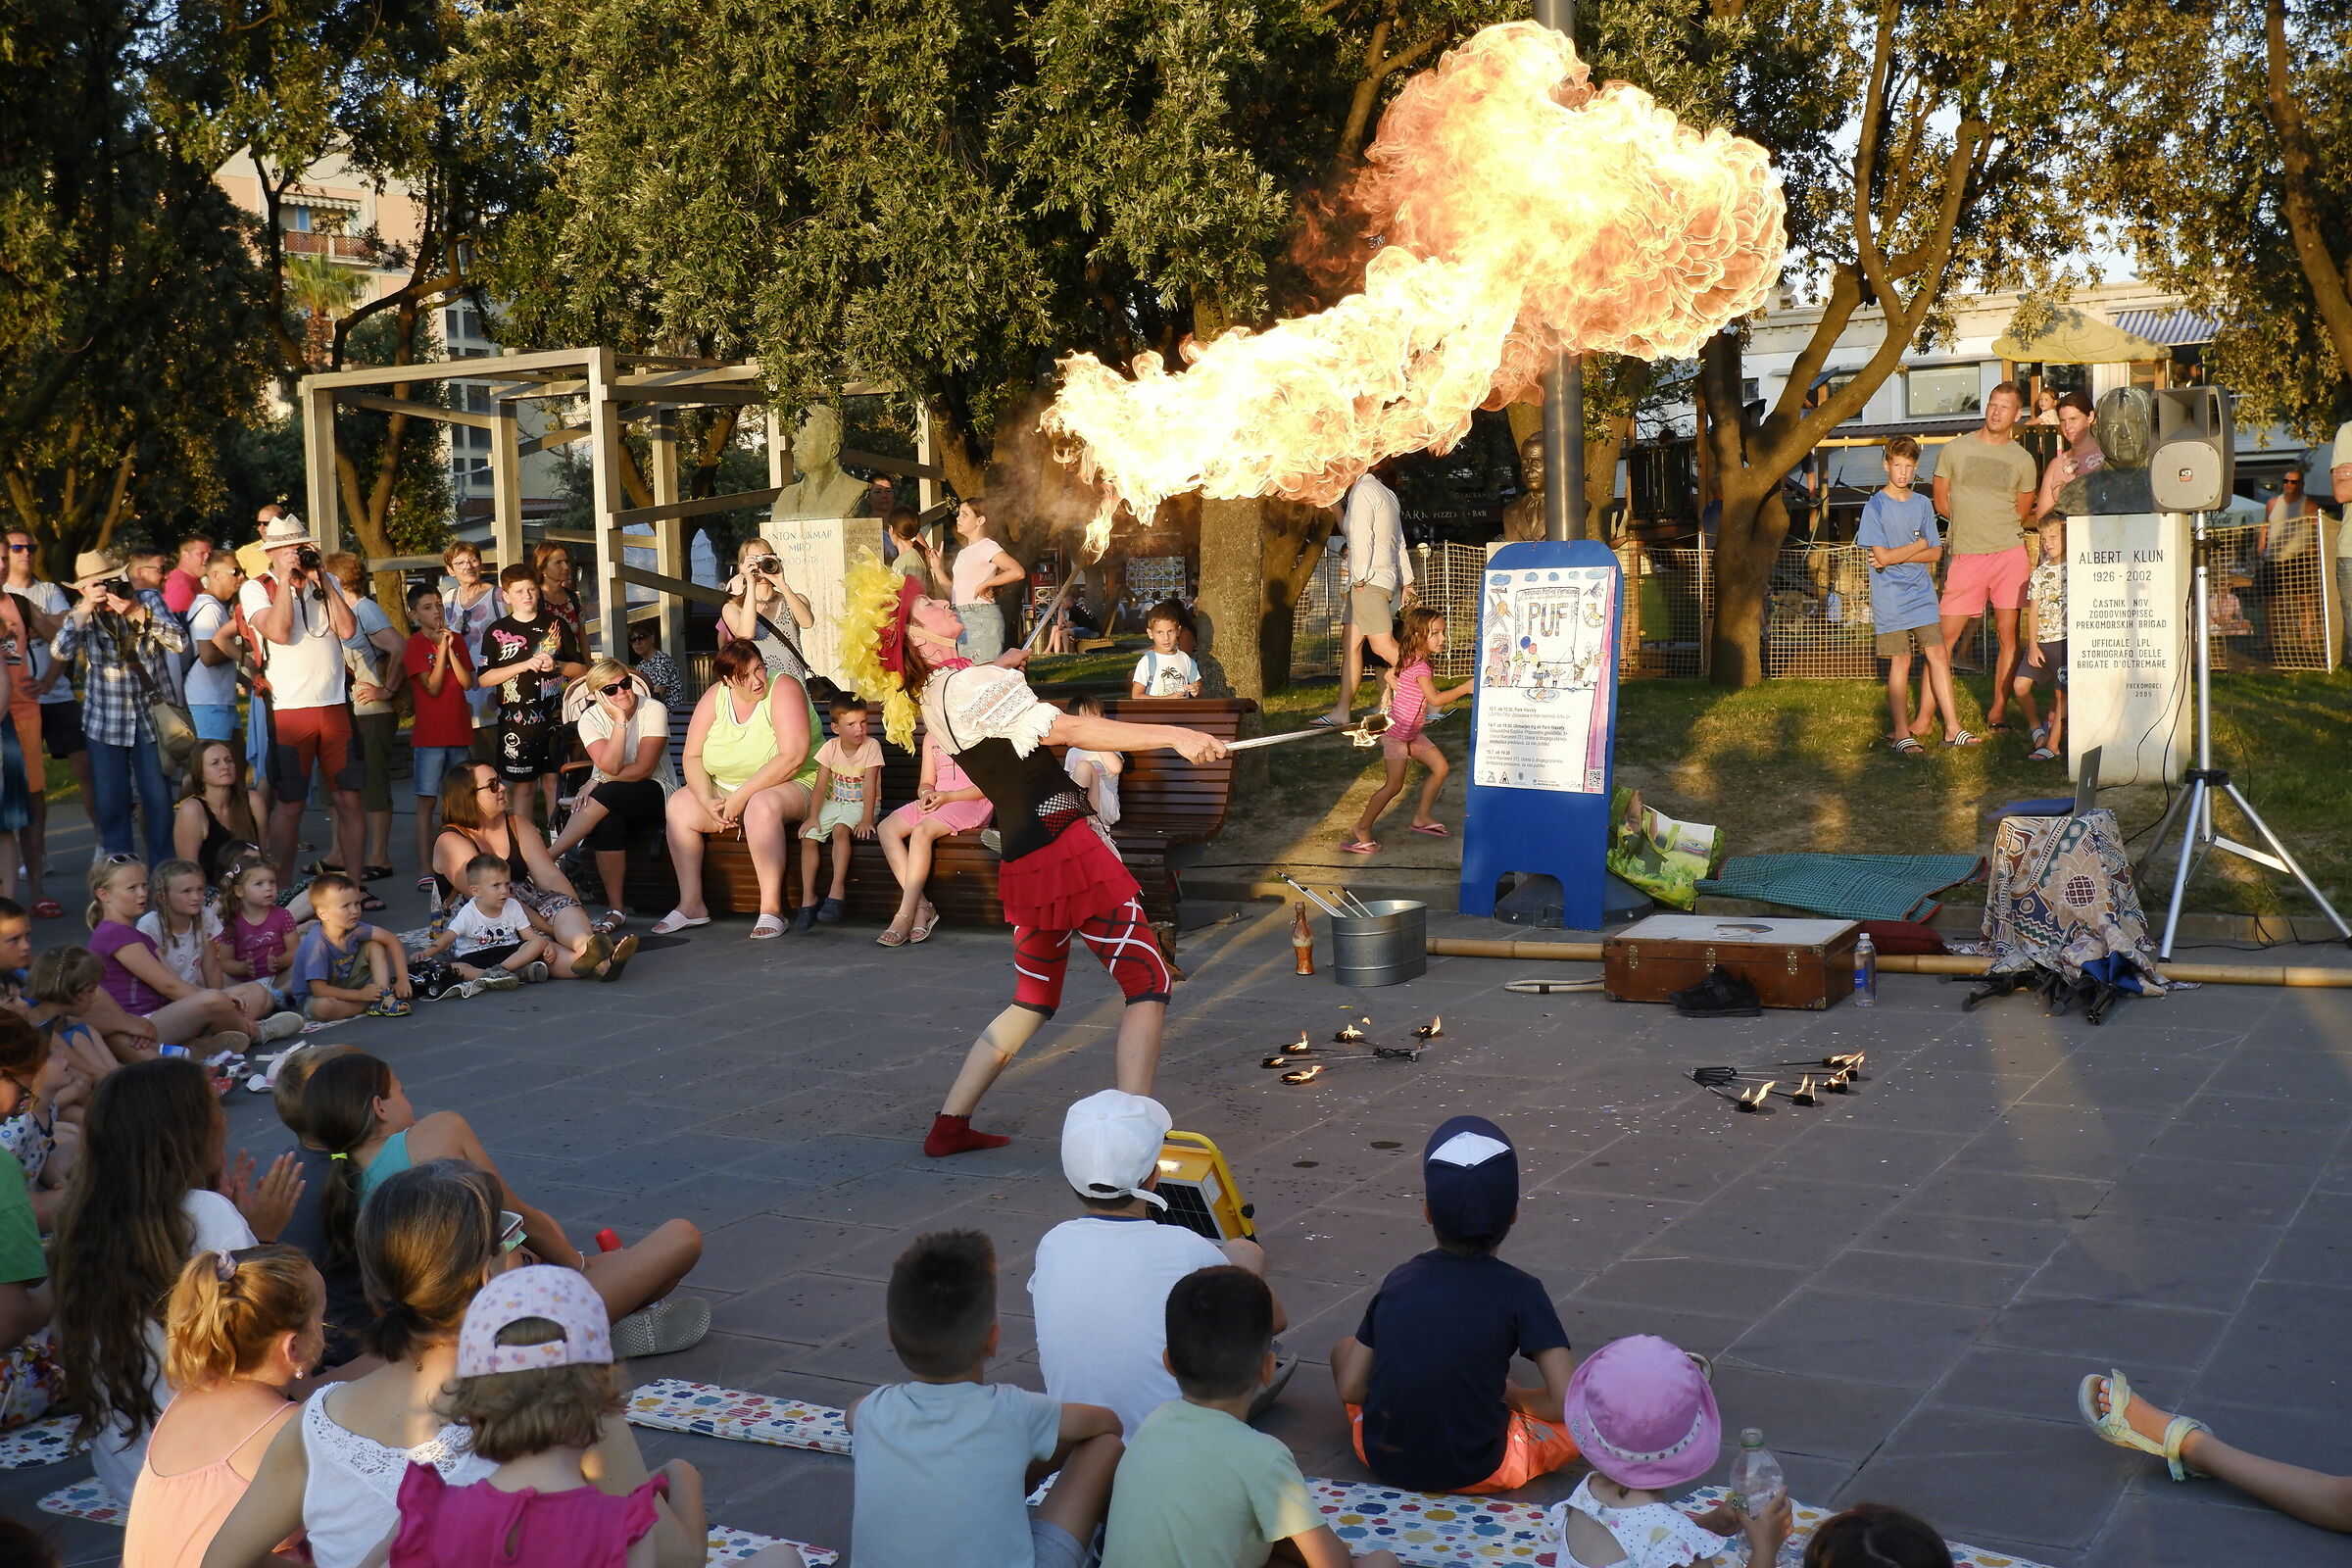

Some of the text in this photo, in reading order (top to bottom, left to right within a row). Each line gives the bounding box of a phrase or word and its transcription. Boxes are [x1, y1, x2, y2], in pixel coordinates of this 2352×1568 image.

[767, 532, 796, 540] ANTON
[2079, 549, 2163, 564] ALBERT KLUN
[2093, 571, 2115, 582] 1926
[2127, 570, 2152, 581] 2002
[2093, 598, 2149, 608] ČASTNIK NOV
[2089, 609, 2154, 619] ZGODOVINOPISEC
[1528, 603, 1568, 637] PUF
[2076, 620, 2167, 629] PREKOMORSKIH BRIGAD
[2092, 639, 2130, 647] UFFICIALE
[2082, 649, 2162, 658] STORIOGRAFO DELLE
[2077, 660, 2167, 669] BRIGATE D'OLTREMARE
[643, 1314, 656, 1352] adidas
